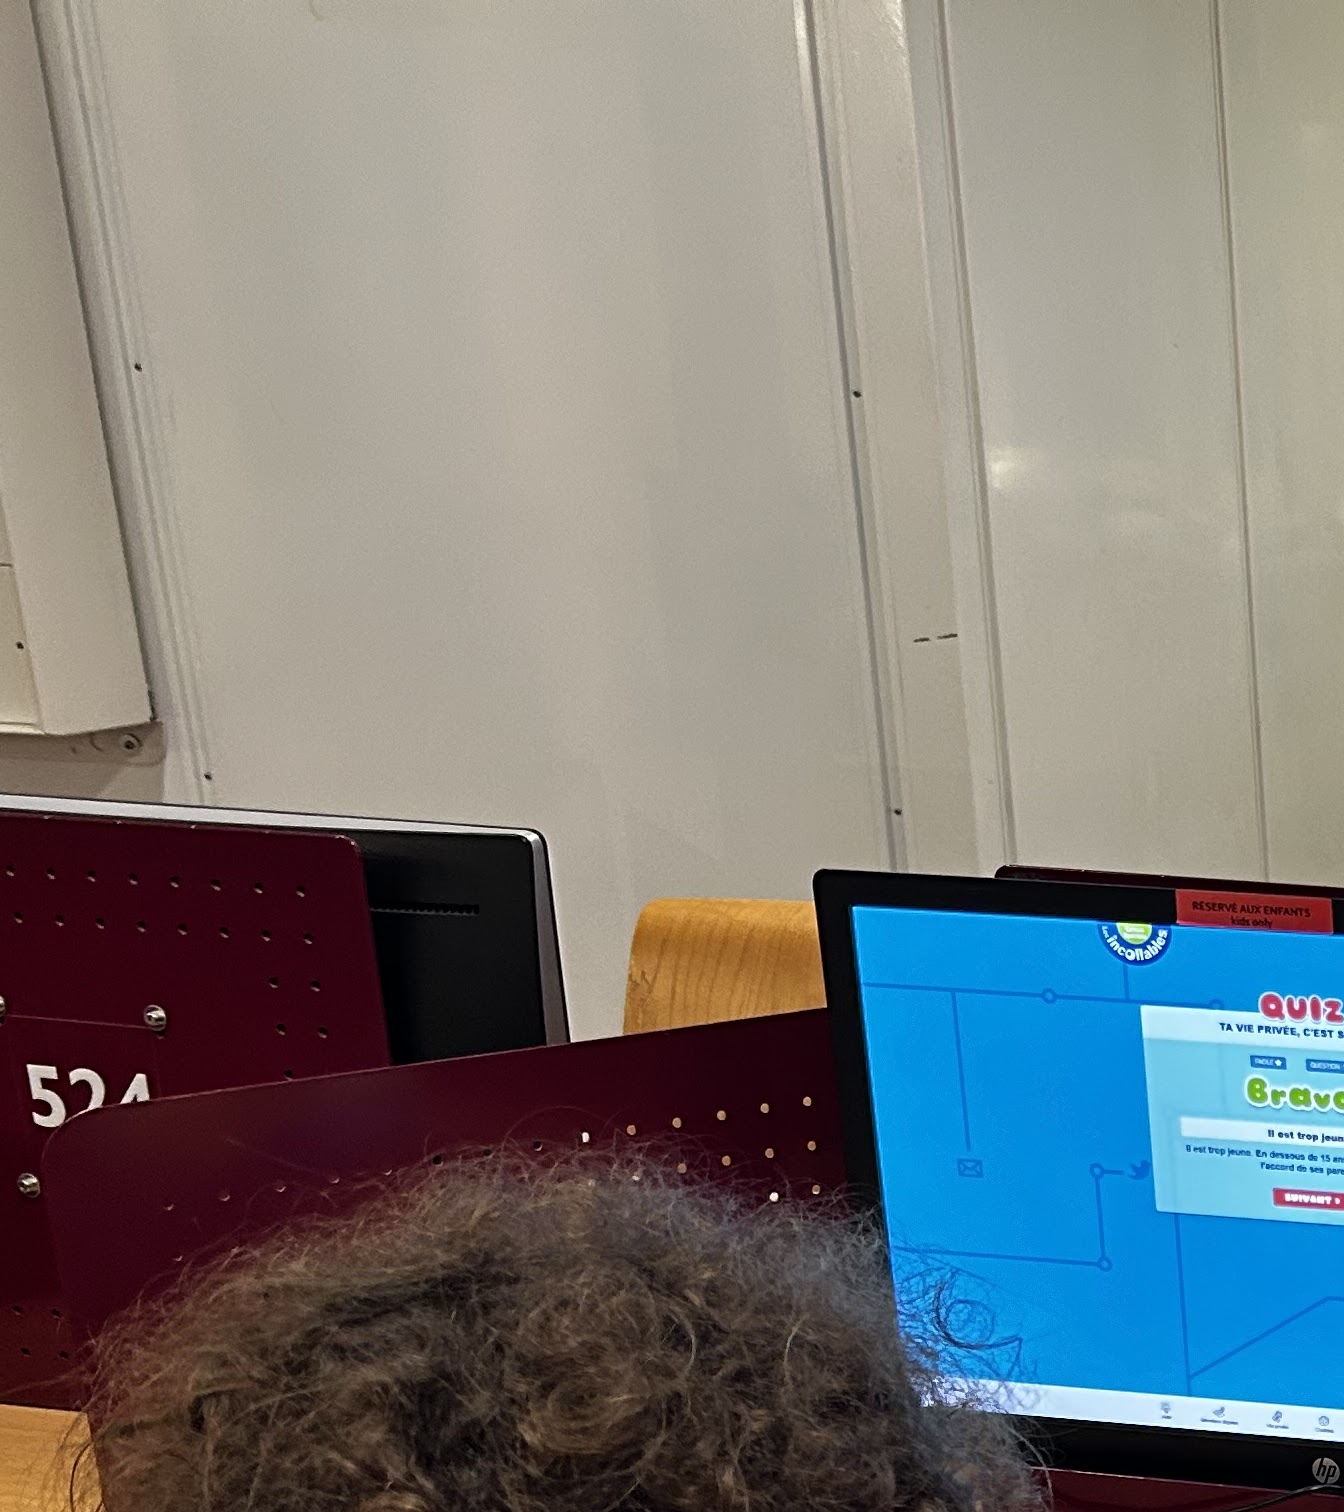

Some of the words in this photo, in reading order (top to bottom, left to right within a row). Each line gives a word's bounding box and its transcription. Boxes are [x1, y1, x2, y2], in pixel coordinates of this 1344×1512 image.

[1240, 905, 1262, 915] AUX
[1263, 906, 1311, 918] ENFANTS
[1107, 929, 1169, 961] incollables
[1259, 993, 1344, 1024] QUIZ
[1219, 1022, 1233, 1032] TA
[1235, 1024, 1254, 1033] VIE
[1257, 1025, 1301, 1038] PRIVÉE,
[1303, 1028, 1334, 1039] C'EST
[1297, 1131, 1319, 1142] trop
[1208, 1147, 1226, 1156] trop
[1270, 1151, 1305, 1160] dessous
[1314, 1457, 1339, 1484] hp
